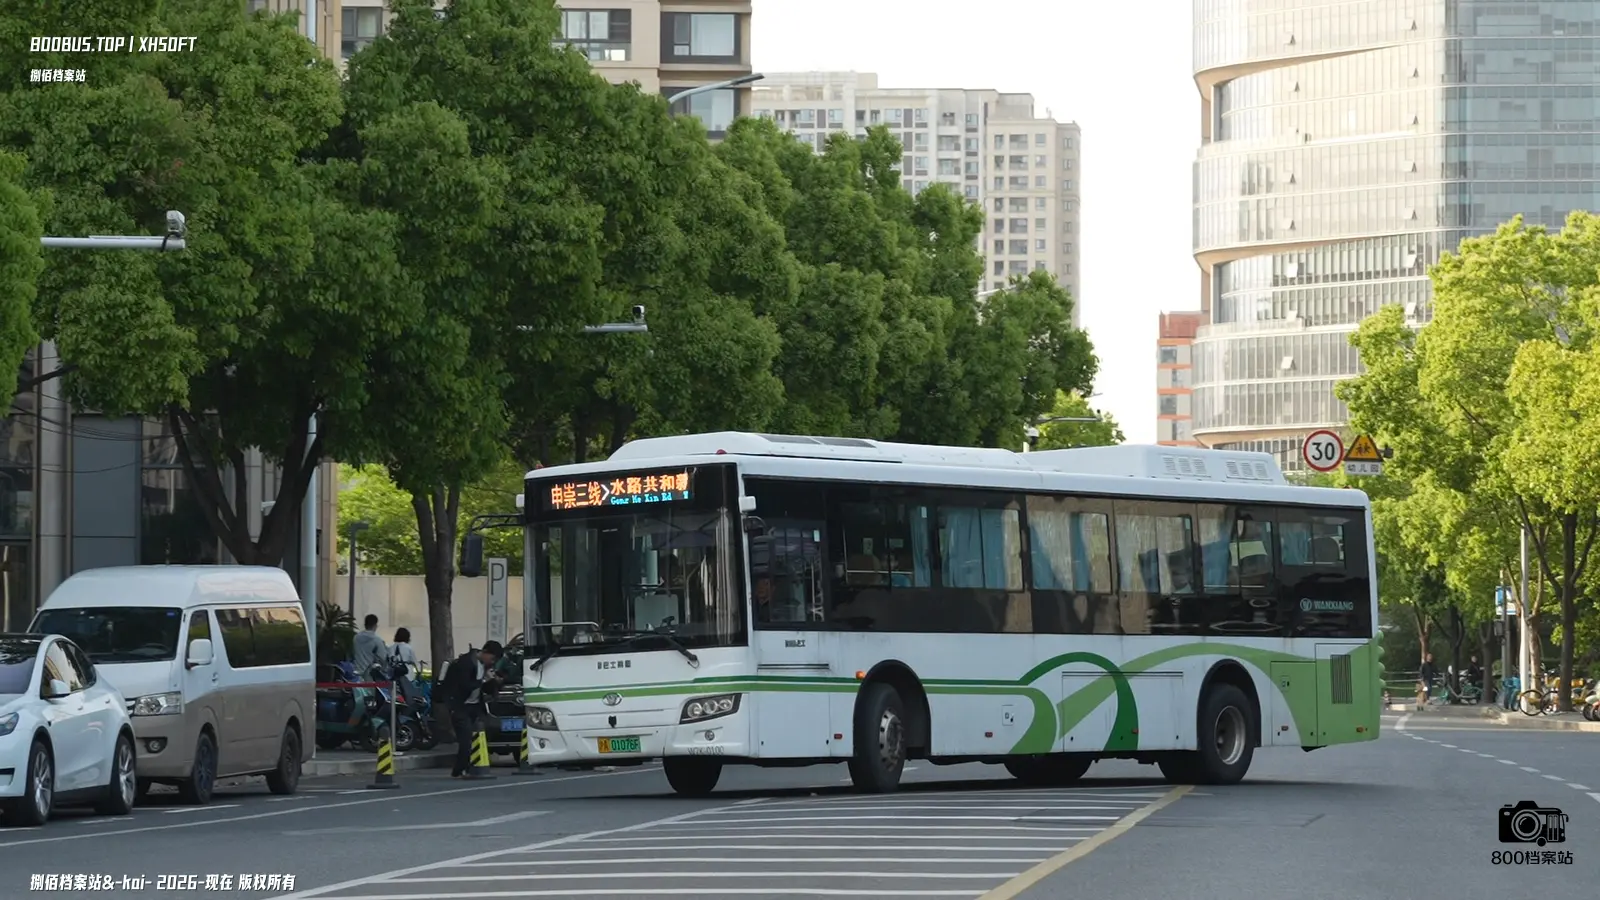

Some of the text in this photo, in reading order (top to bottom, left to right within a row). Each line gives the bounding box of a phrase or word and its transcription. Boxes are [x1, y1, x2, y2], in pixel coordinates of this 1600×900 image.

[1312, 442, 1335, 460] 30
[1347, 464, 1379, 473] 幼儿园
[551, 481, 602, 509] 申崇三线
[644, 493, 659, 503] Xin
[491, 563, 504, 595] P
[1313, 600, 1353, 610] WANXIANG
